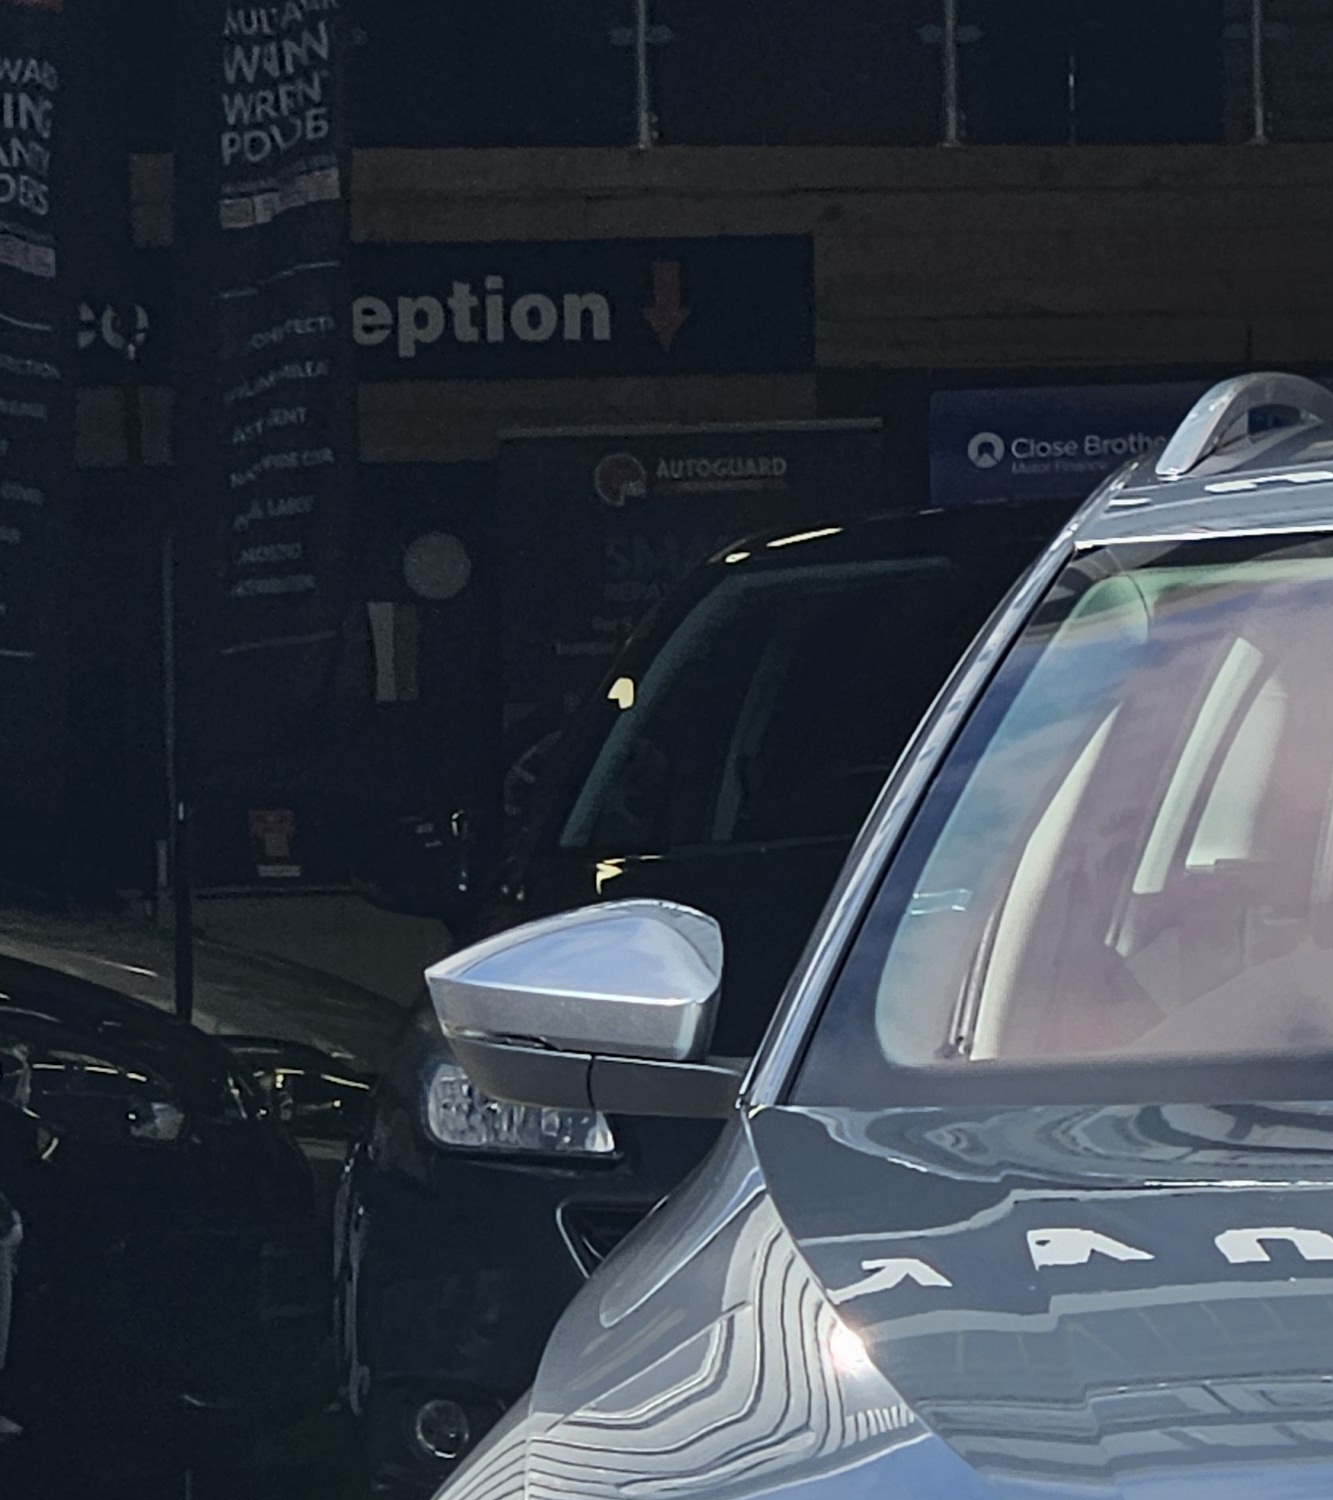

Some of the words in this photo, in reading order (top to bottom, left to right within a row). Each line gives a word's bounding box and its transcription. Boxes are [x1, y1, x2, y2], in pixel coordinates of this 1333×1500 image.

[352, 275, 611, 357] eption
[1011, 436, 1079, 459] Close
[1084, 432, 1168, 456] Brothe
[656, 457, 787, 479] AUTOGUARD
